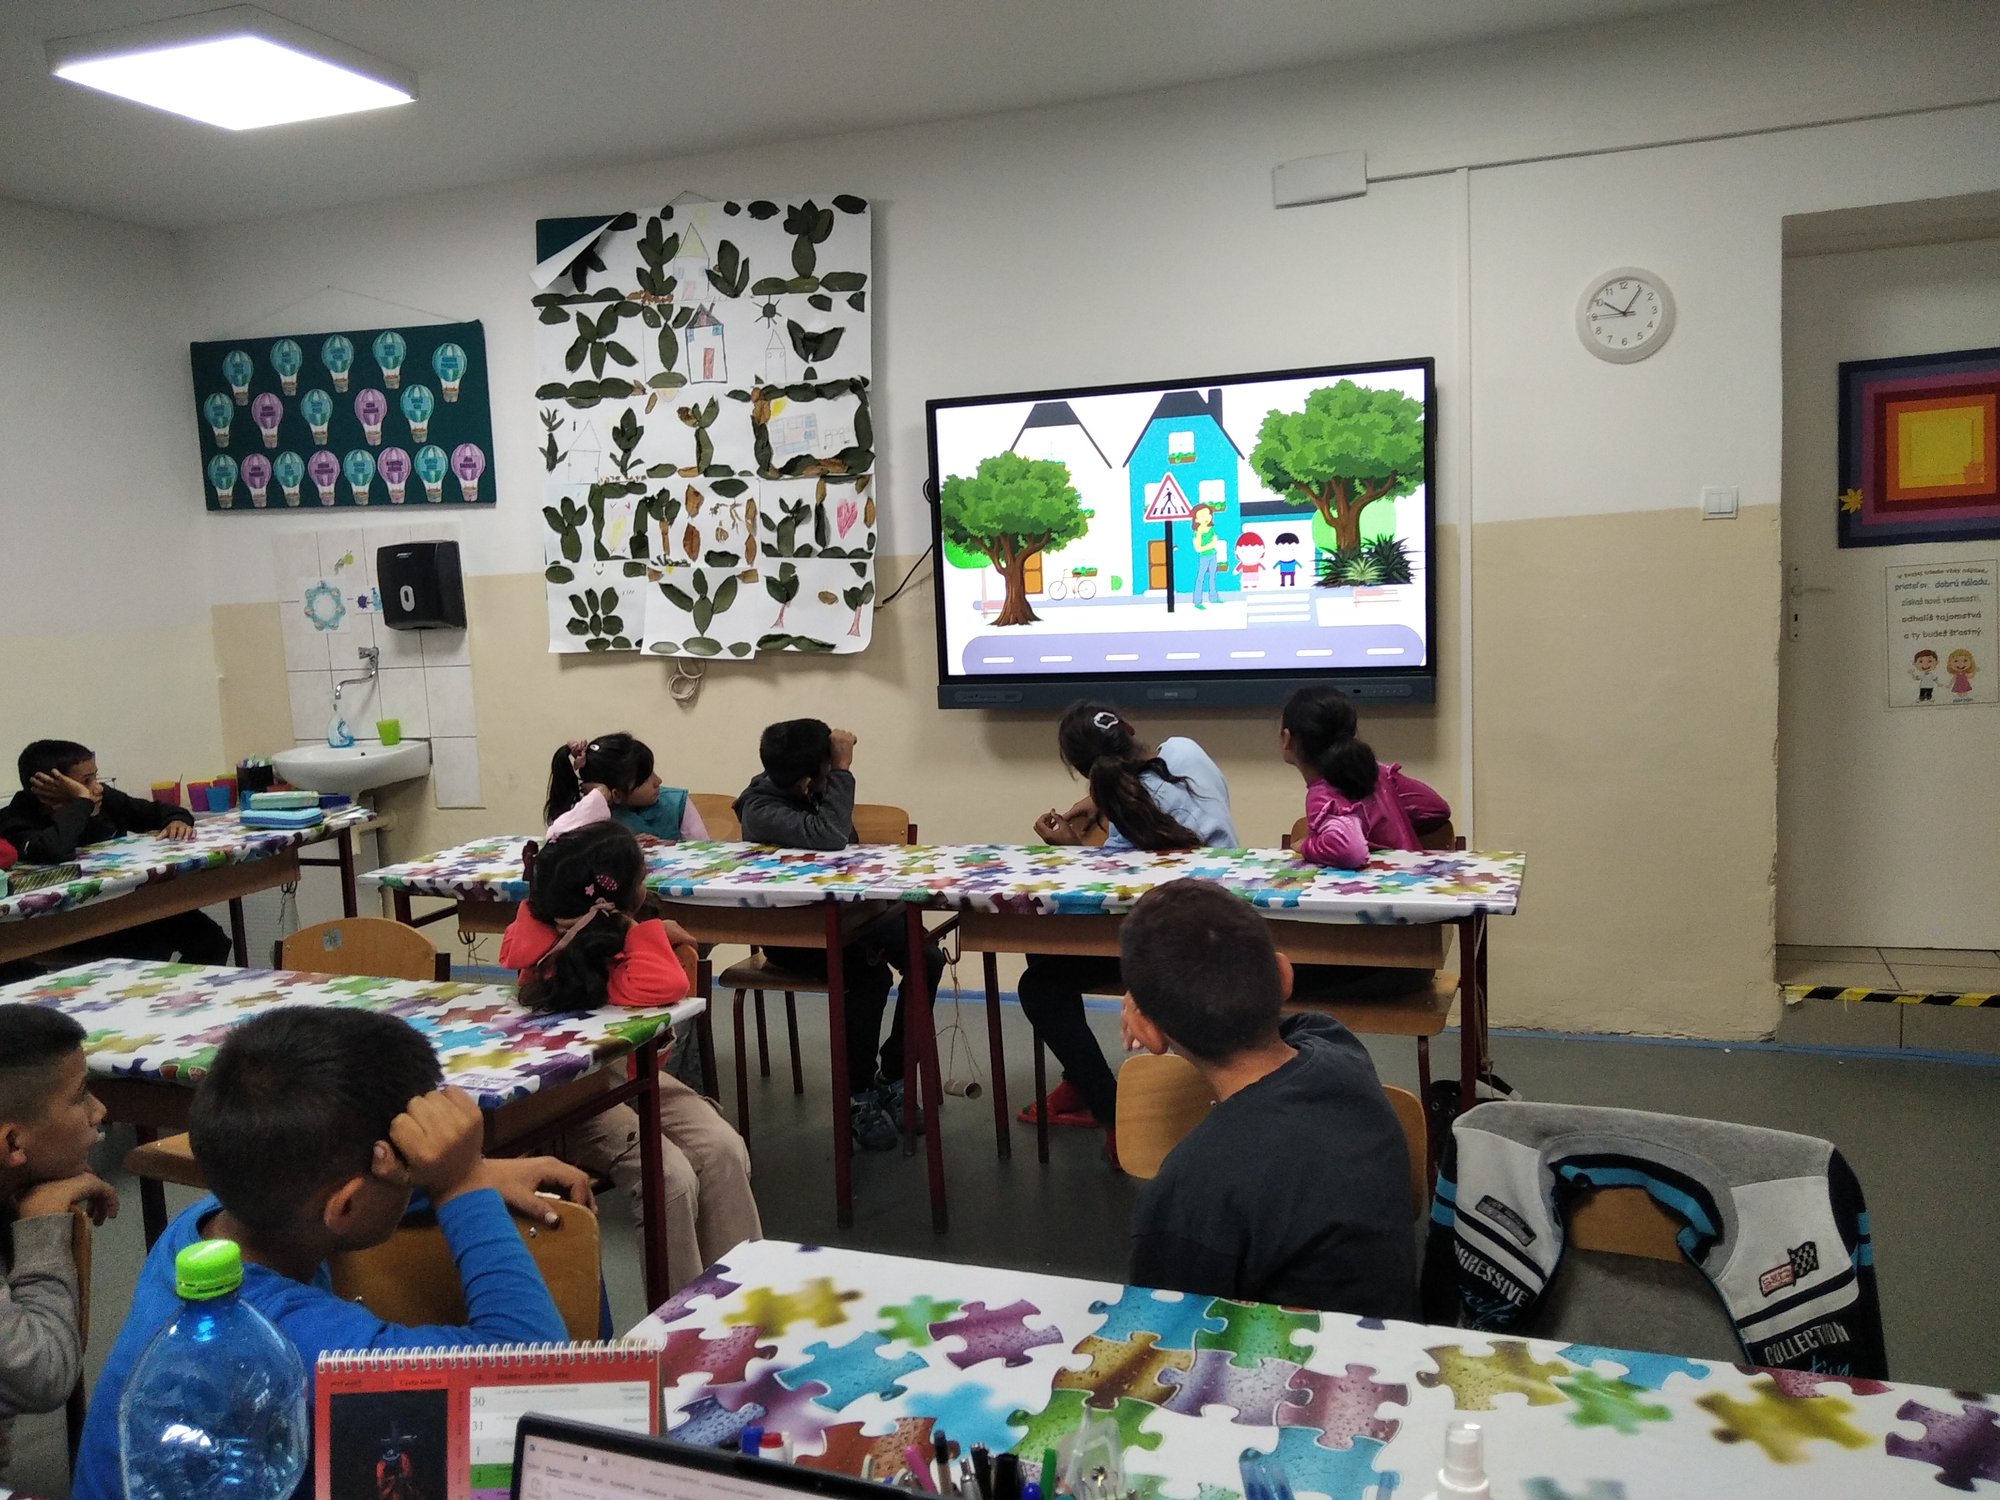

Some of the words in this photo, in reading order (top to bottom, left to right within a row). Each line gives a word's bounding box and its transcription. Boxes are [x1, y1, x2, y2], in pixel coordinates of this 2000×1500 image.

[1619, 281, 1628, 290] 12
[1605, 288, 1613, 296] 11
[1935, 579, 1959, 588] dobrú
[1902, 613, 1933, 623] odhalíš
[1936, 611, 1982, 622] tajomstvá
[1911, 631, 1921, 640] ty
[1923, 629, 1947, 638] budeš
[1764, 1321, 1850, 1366] COLLECTION
[472, 1396, 485, 1408] 30
[472, 1421, 484, 1431] 31
